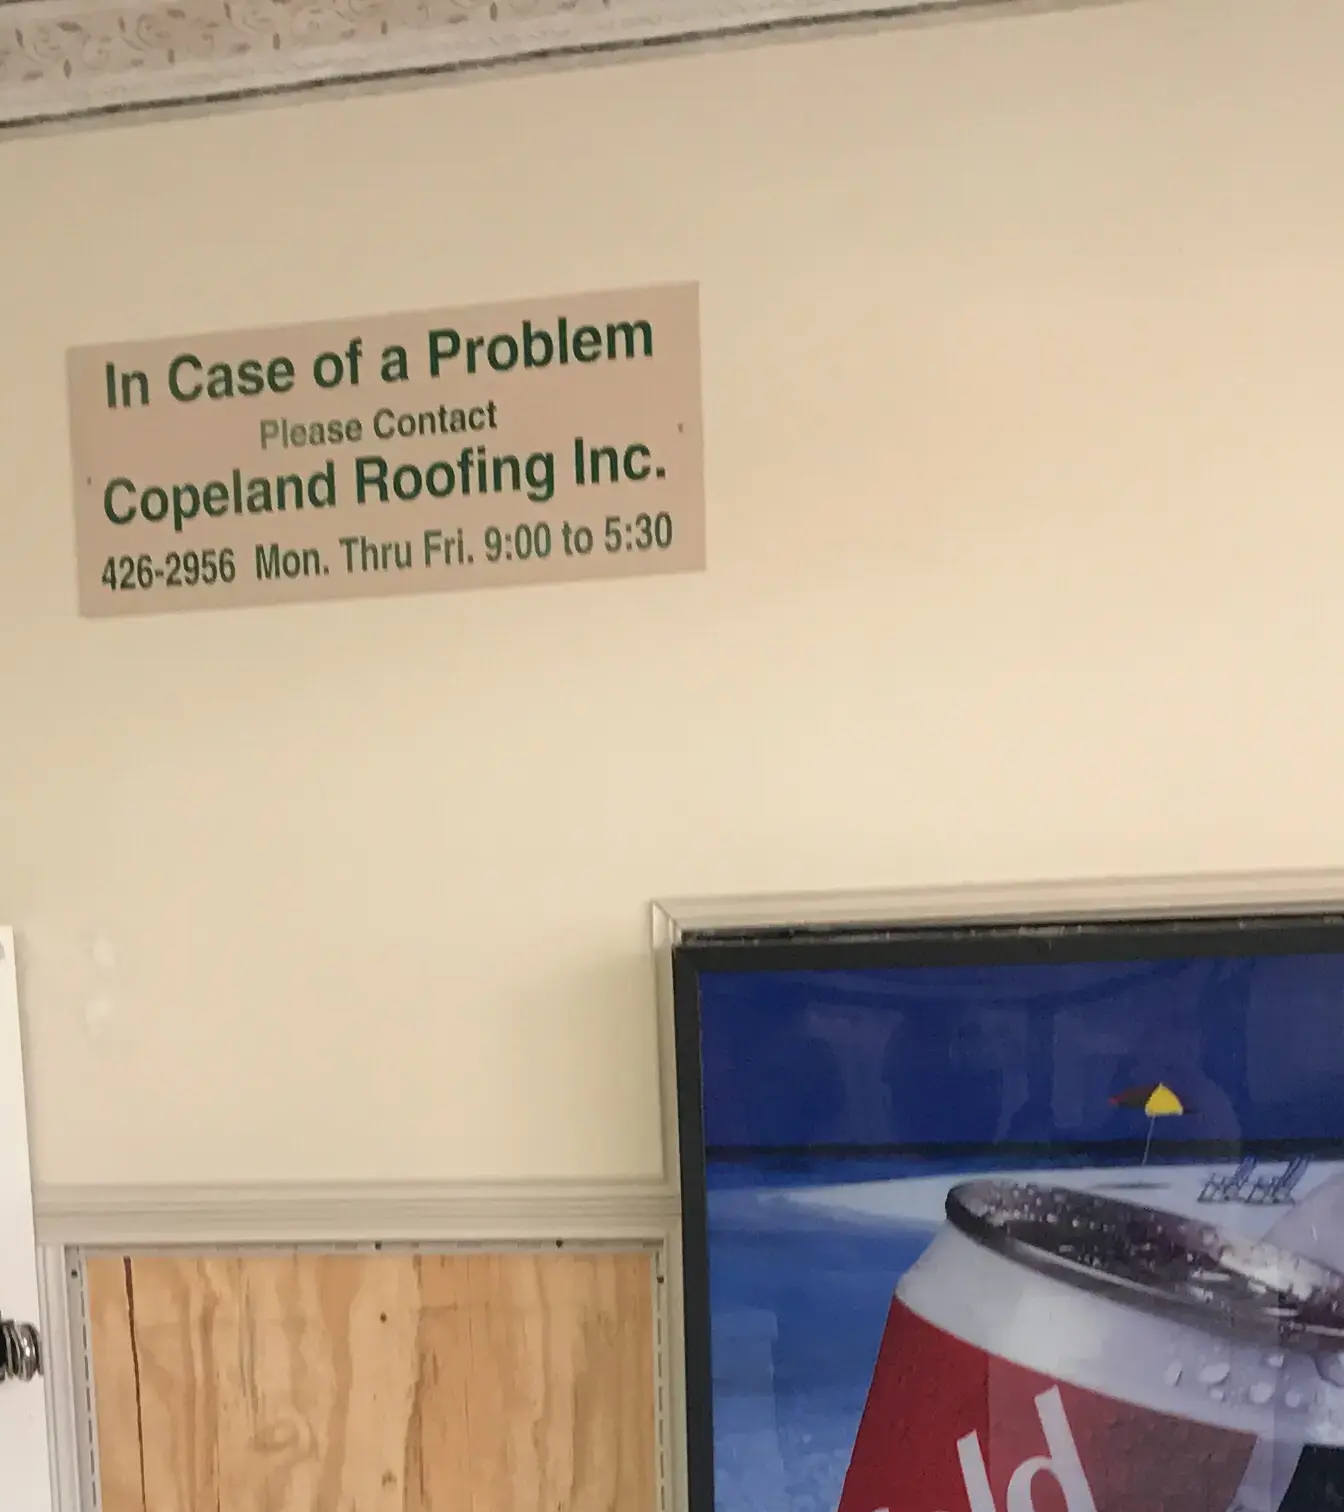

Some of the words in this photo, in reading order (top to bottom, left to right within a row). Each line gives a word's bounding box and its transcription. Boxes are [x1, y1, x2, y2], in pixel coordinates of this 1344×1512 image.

[105, 361, 150, 409] In
[167, 352, 296, 404] Case
[312, 338, 364, 390] of
[380, 344, 410, 384] a
[428, 316, 655, 379] Problem
[259, 411, 363, 451] Please
[373, 399, 499, 441] Contact
[103, 460, 338, 532] Copeland
[355, 446, 557, 504] Roofing
[573, 436, 668, 484] Inc.
[101, 548, 237, 592] 426-2956
[254, 542, 330, 581] Mon.
[338, 533, 413, 575] Thru
[423, 527, 474, 570] Fri.
[484, 521, 552, 563] 9:00
[561, 520, 594, 557] to
[603, 512, 674, 553] 5:30
